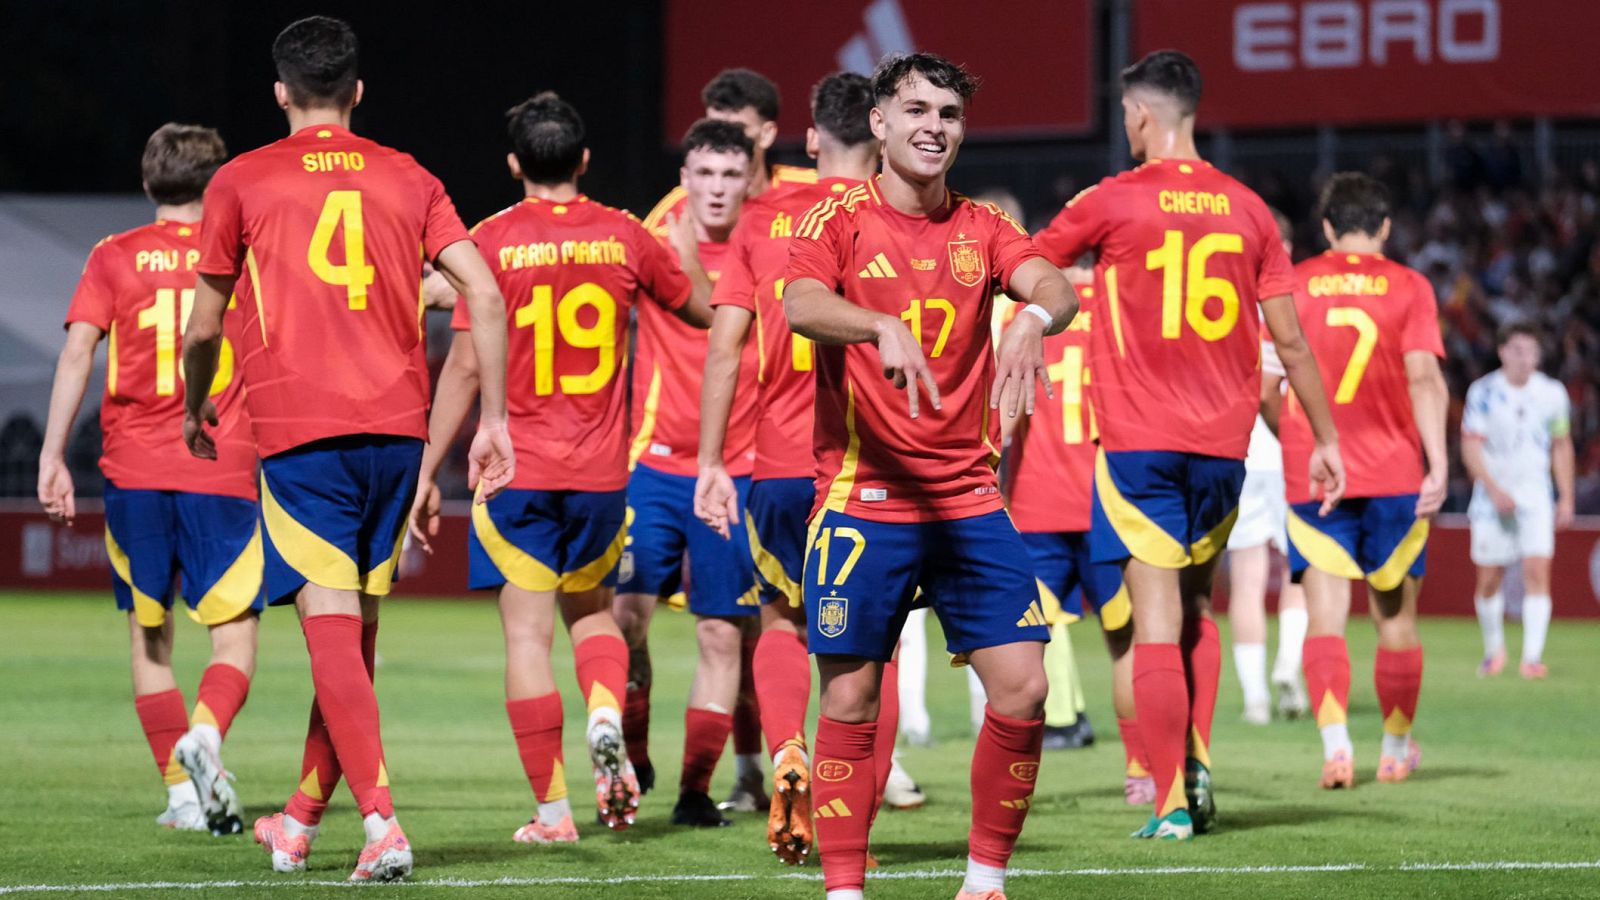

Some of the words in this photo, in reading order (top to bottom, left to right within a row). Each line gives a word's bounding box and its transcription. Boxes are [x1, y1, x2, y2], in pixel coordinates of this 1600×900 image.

[302, 151, 365, 172] SIMO
[1158, 189, 1231, 216] CHEMA
[136, 249, 178, 273] PAU
[307, 190, 375, 311] 4
[499, 242, 558, 271] MARIO
[561, 235, 627, 266] MARTÍN
[1146, 229, 1244, 342] 16
[1308, 272, 1389, 298] GONZALO
[515, 282, 616, 396] 19
[901, 298, 956, 358] 17
[1326, 307, 1378, 405] 7
[815, 527, 866, 586] 17
